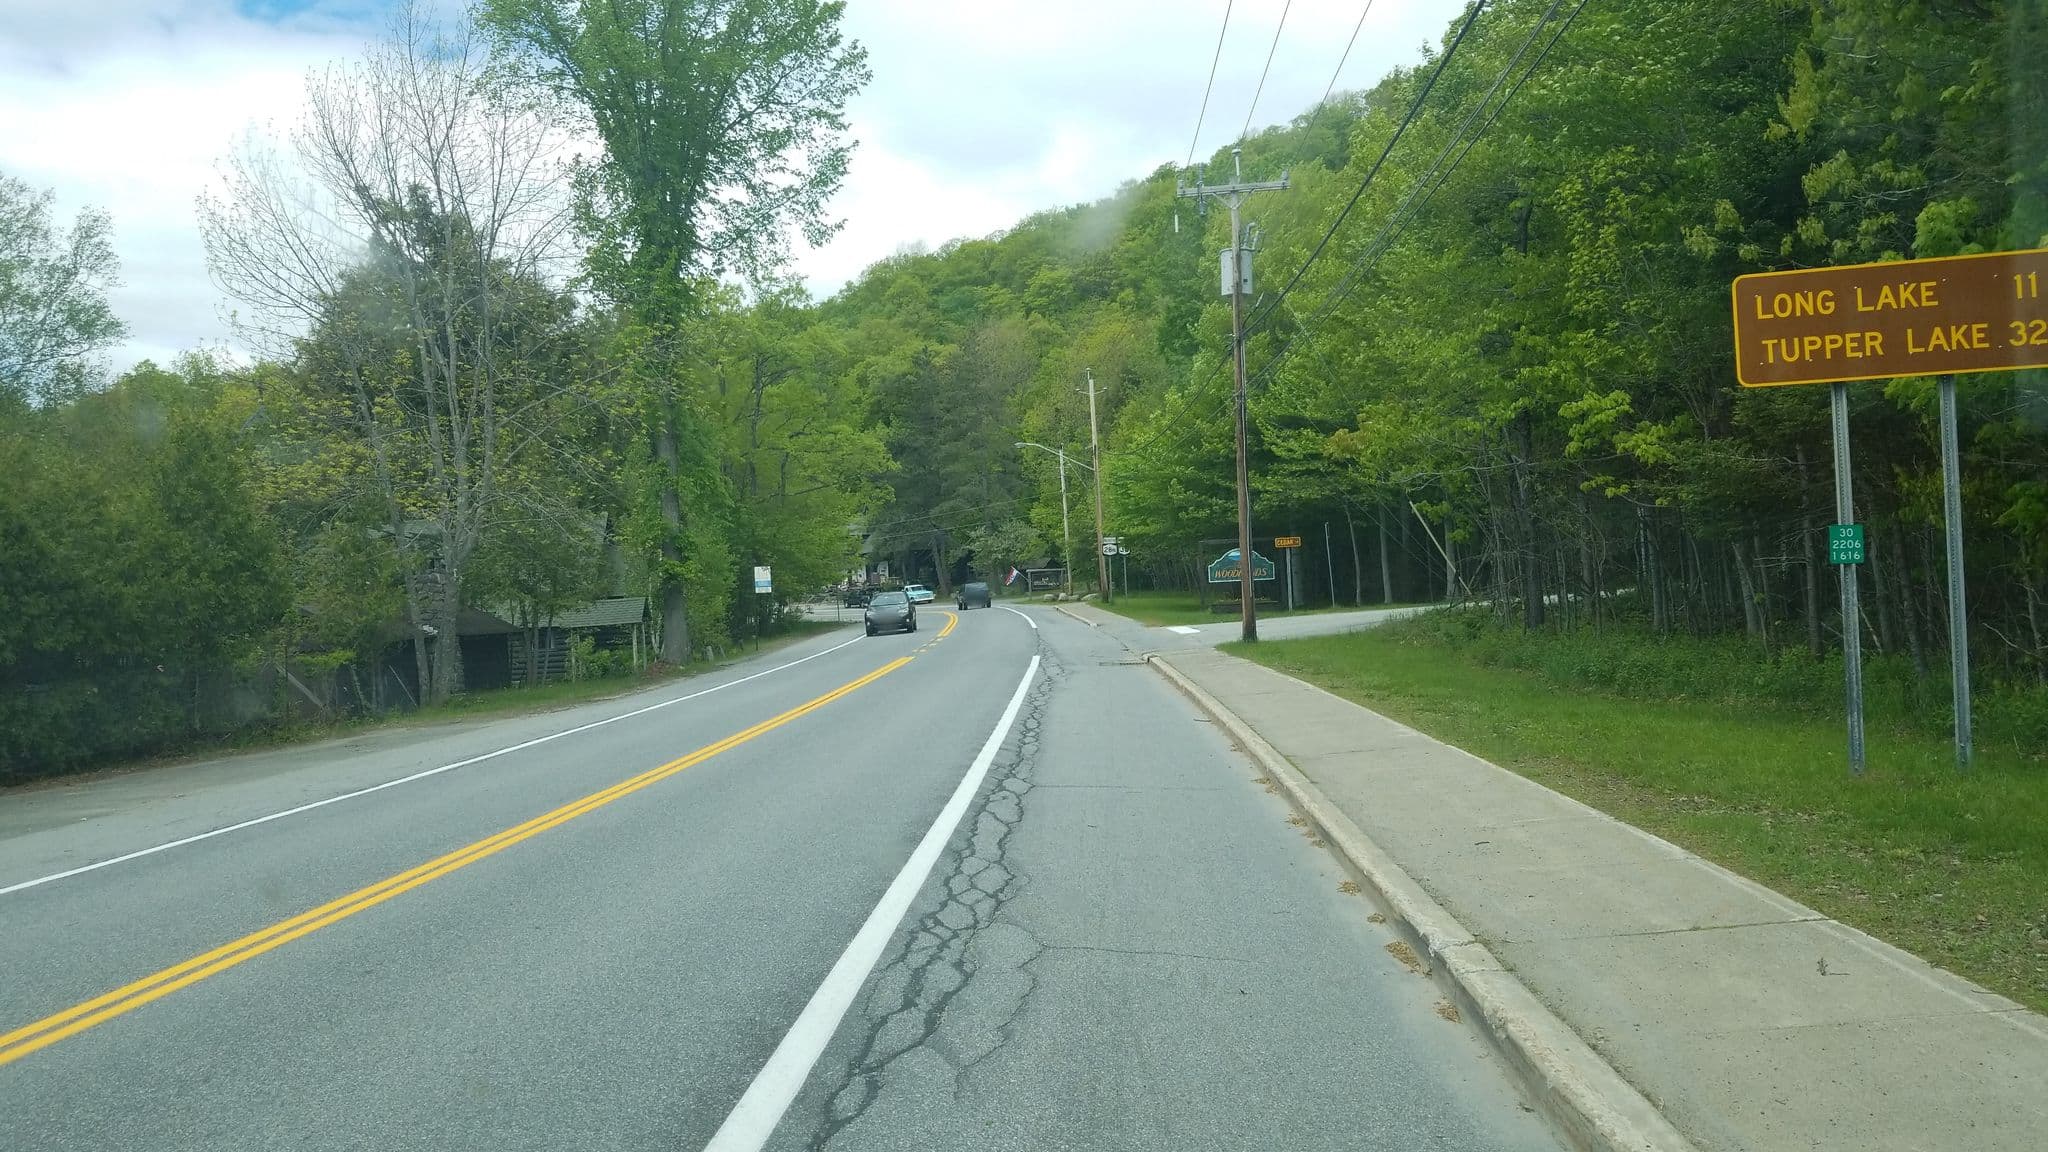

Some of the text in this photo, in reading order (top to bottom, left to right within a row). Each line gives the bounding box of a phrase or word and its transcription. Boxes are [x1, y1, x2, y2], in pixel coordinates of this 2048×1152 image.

[1755, 273, 2038, 320] LONG LAKE 11
[1761, 318, 2048, 364] TUPPER LAKE 32
[1839, 528, 1854, 537] 30
[1832, 540, 1861, 549] 2206
[1833, 551, 1861, 560] 1616
